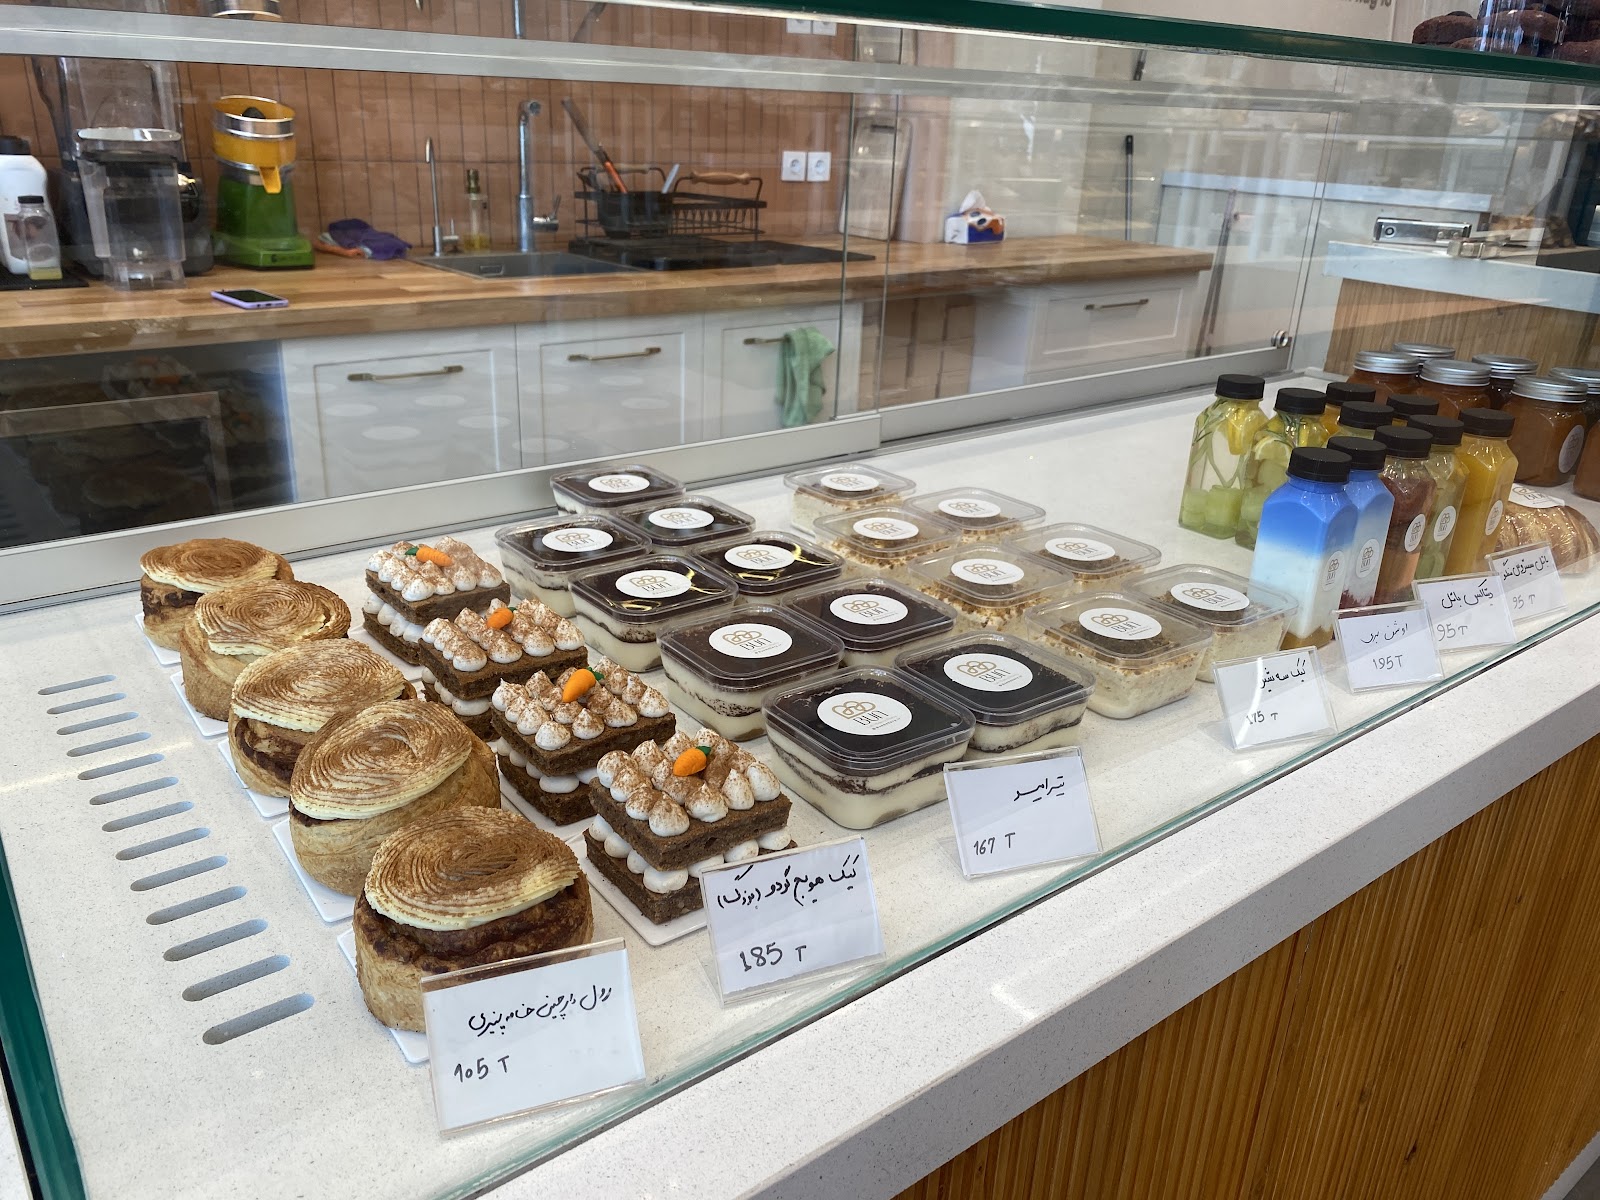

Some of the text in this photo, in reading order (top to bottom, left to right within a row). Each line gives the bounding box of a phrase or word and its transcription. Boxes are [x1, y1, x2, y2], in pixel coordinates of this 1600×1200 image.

[1436, 623, 1456, 641] 95
[1275, 672, 1289, 681] سه
[1290, 657, 1306, 683] کیک
[1013, 775, 1065, 803] تیرامیسو
[973, 832, 1016, 856] 167 T
[765, 864, 792, 898] گردو
[828, 854, 860, 890] کیک
[793, 874, 824, 907] هویج
[739, 942, 807, 972] 185 T
[468, 984, 612, 1038] رول دارچینی خامه پنیری
[453, 1055, 510, 1083] 105 T
